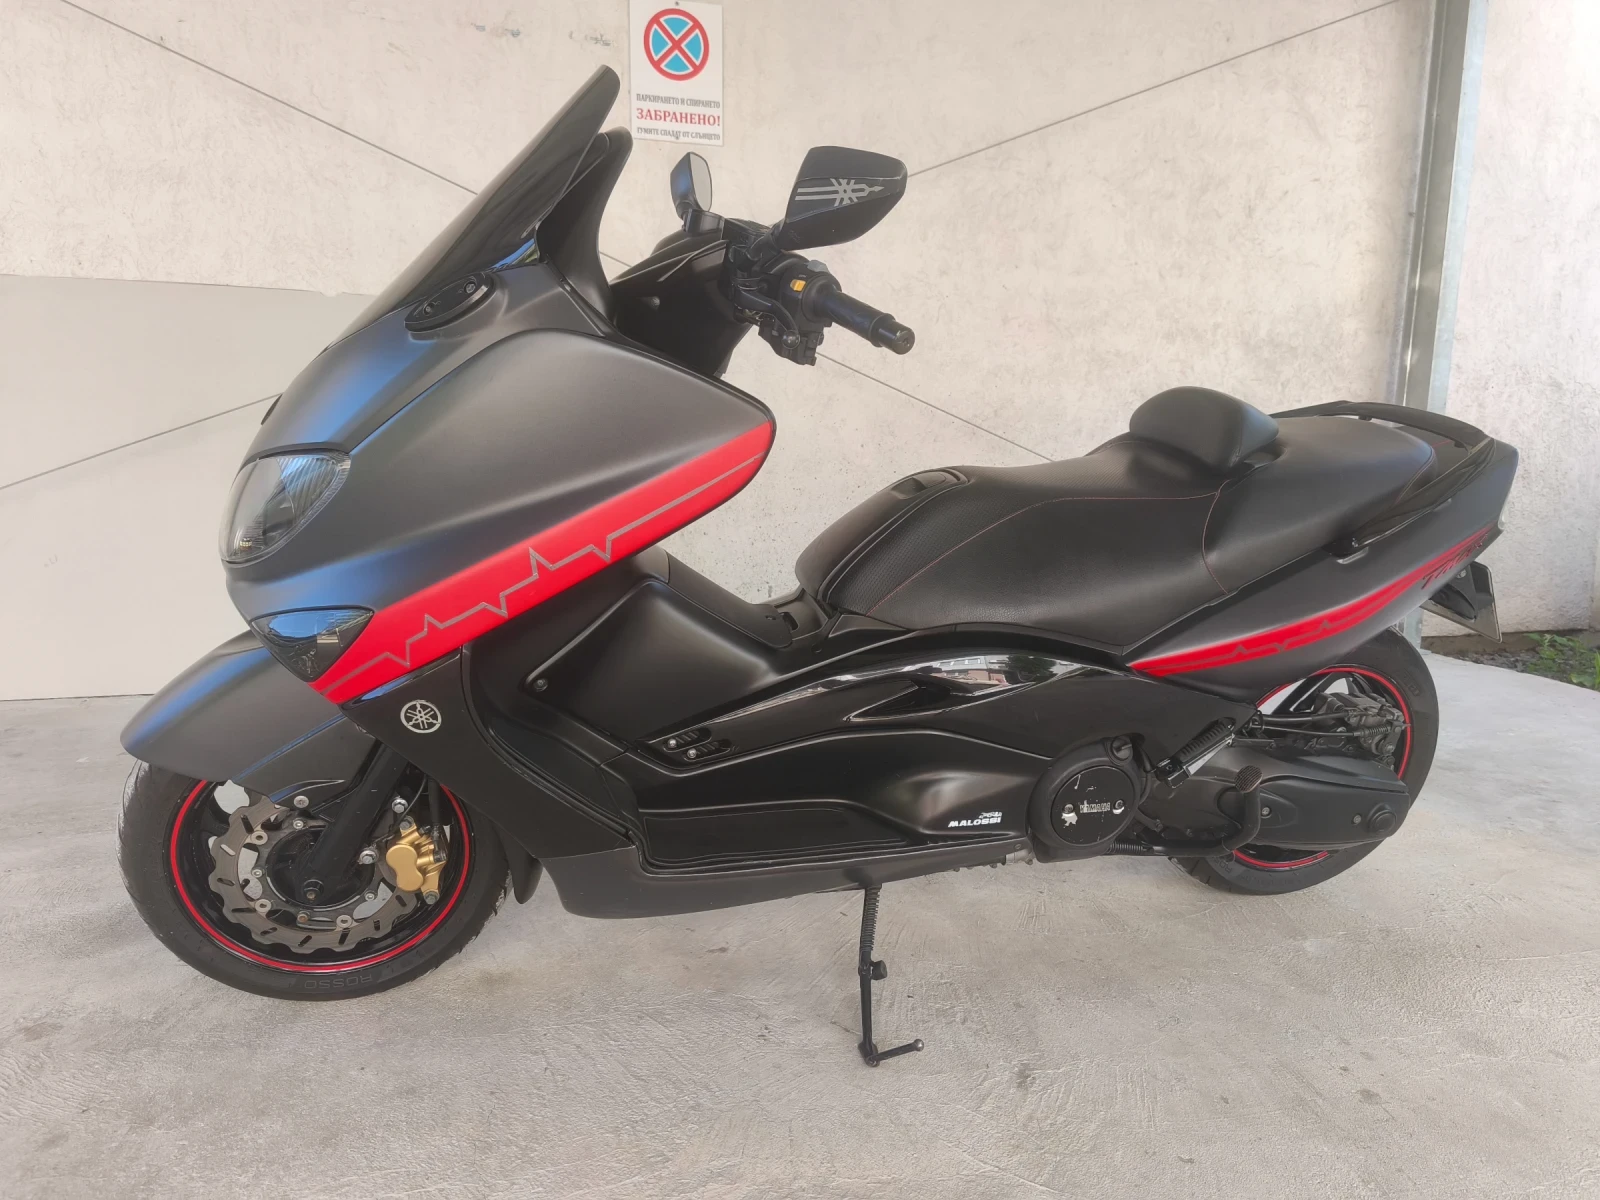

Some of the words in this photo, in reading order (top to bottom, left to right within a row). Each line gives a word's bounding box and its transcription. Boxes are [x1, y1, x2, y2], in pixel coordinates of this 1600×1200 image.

[636, 94, 679, 105] ПАРКИРАНЕТО
[686, 98, 720, 108] СПИРАНЕТО
[636, 108, 720, 126] ЗАБРАНЕНО!
[947, 816, 1002, 828] MALOSSI
[304, 975, 371, 988] ROSSO
